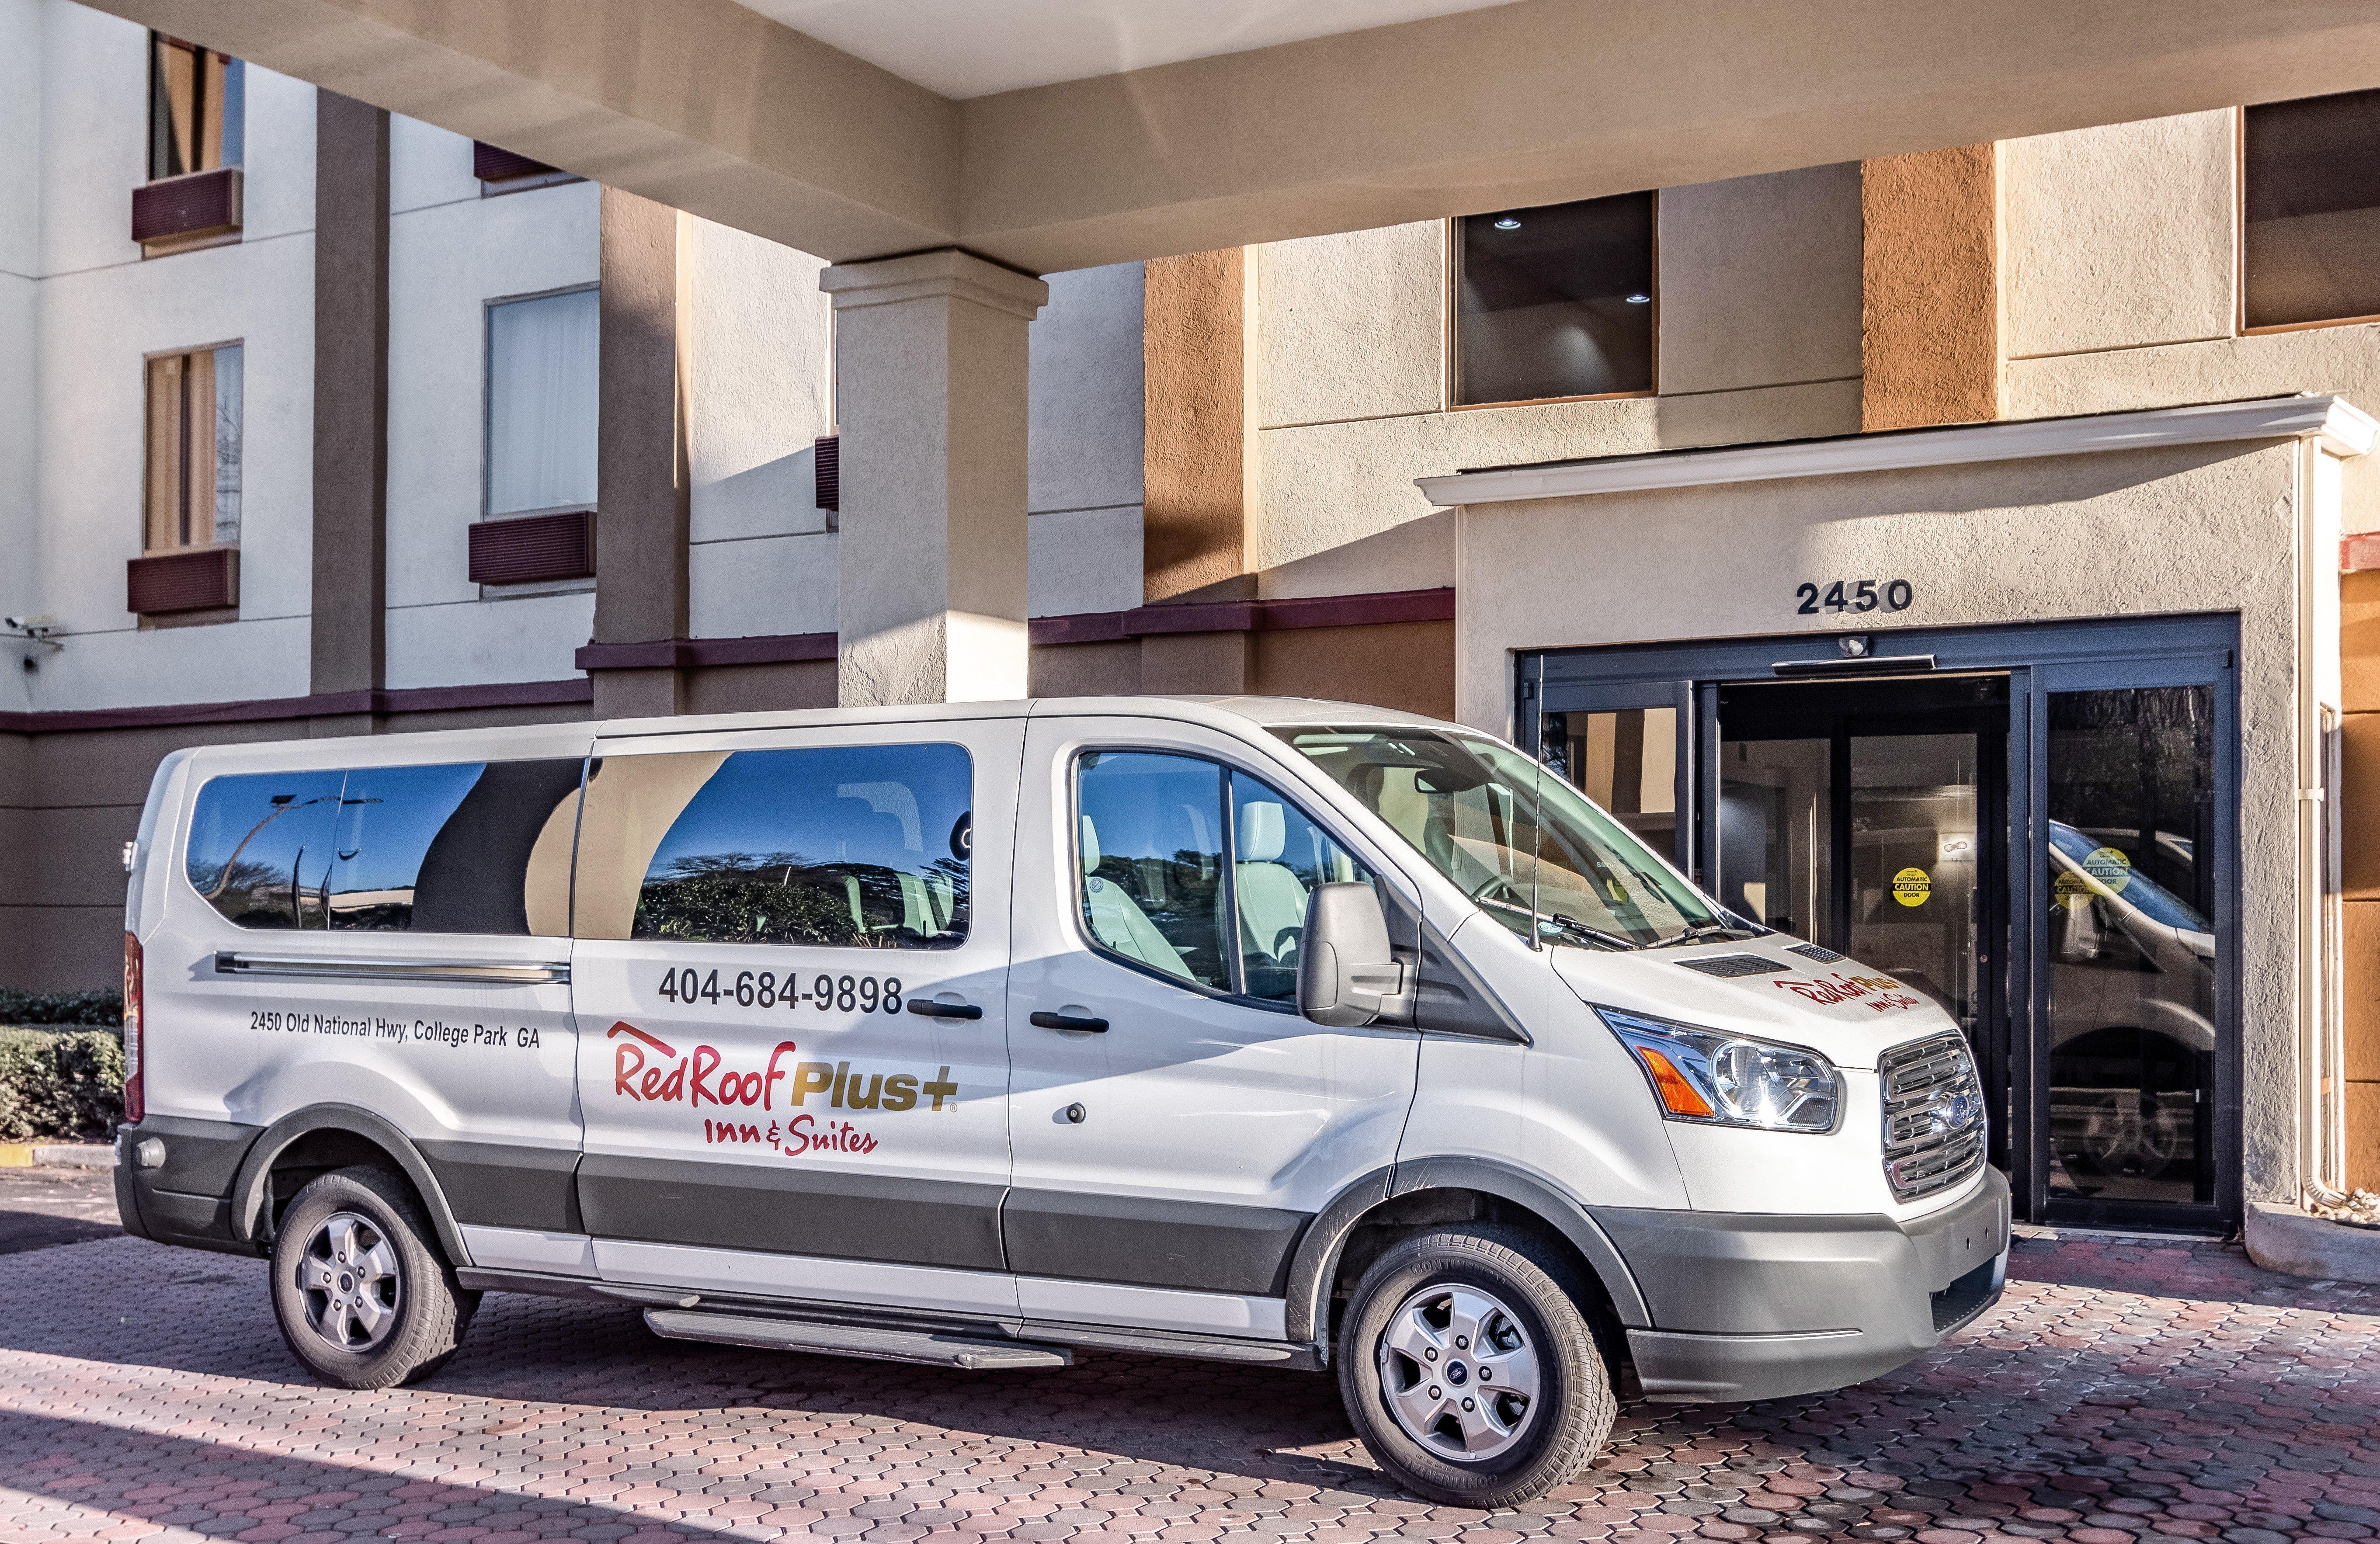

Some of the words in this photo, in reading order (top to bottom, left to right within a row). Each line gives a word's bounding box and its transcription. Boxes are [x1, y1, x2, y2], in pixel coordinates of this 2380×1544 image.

[1796, 578, 1912, 614] 2450
[658, 967, 902, 1014] 404-684-9898
[250, 1011, 282, 1031] 2450
[286, 1012, 309, 1033] Old
[313, 1014, 371, 1037] National
[376, 1017, 408, 1044] Hwy,
[414, 1020, 469, 1048] College
[473, 1024, 507, 1046] Park
[517, 1027, 540, 1048] GA
[767, 1119, 782, 1151] &
[785, 1114, 879, 1156] Suites
